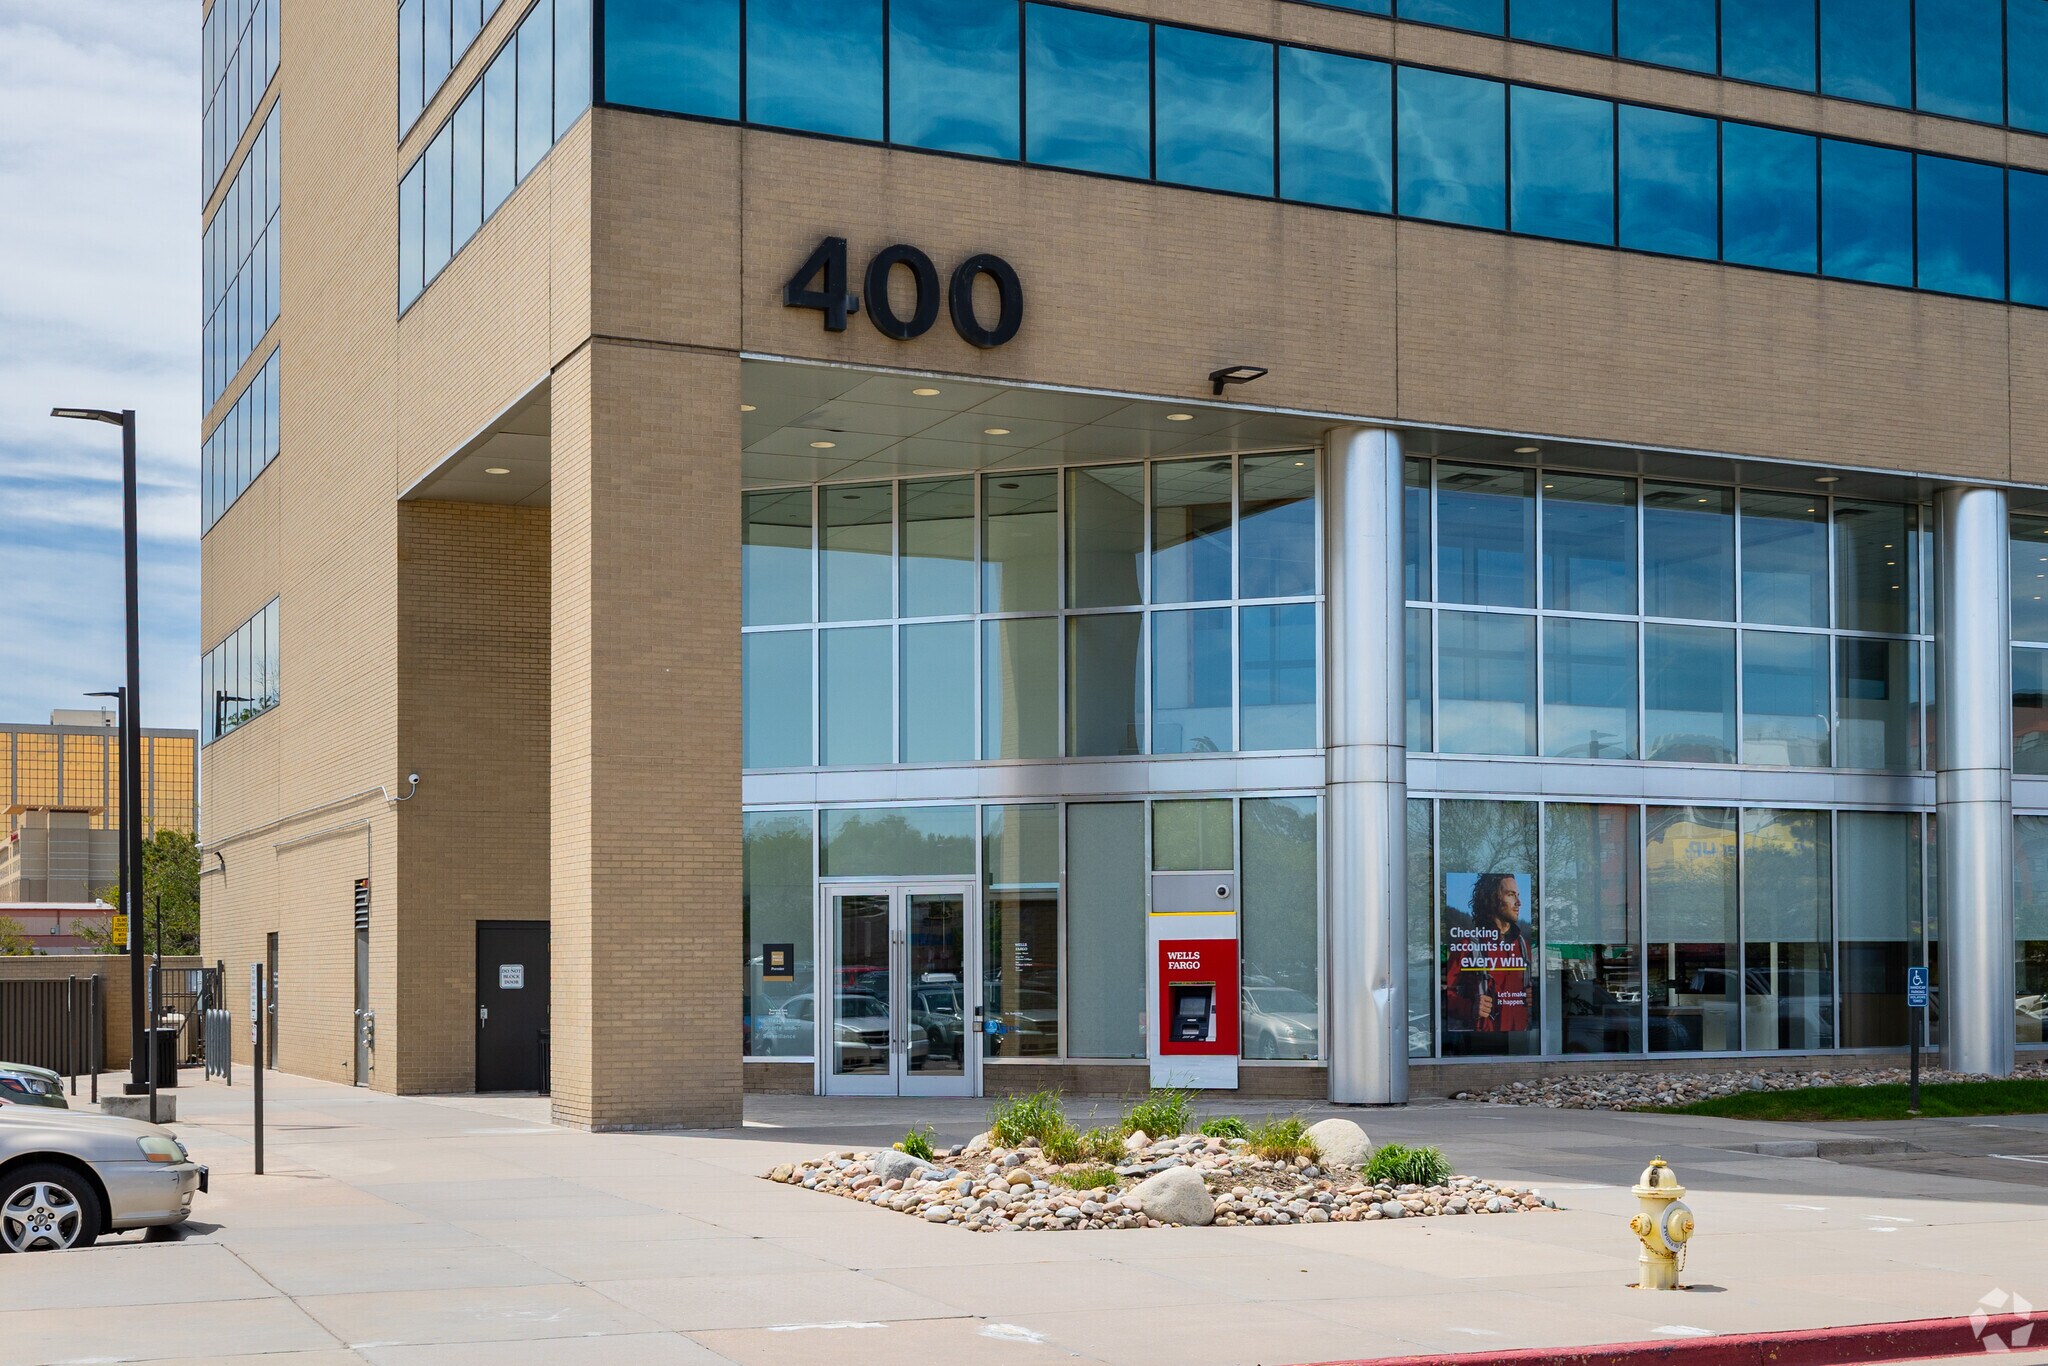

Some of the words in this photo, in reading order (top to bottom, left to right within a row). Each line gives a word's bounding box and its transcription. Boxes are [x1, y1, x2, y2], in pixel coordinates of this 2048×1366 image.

[783, 236, 1024, 349] 400
[1450, 927, 1498, 940] Checking
[1450, 942, 1498, 952] accounts
[1499, 941, 1515, 952] for
[1167, 951, 1200, 960] WELLS
[1168, 961, 1201, 970] FARGO
[1461, 957, 1498, 971] every
[1500, 953, 1528, 967] win.
